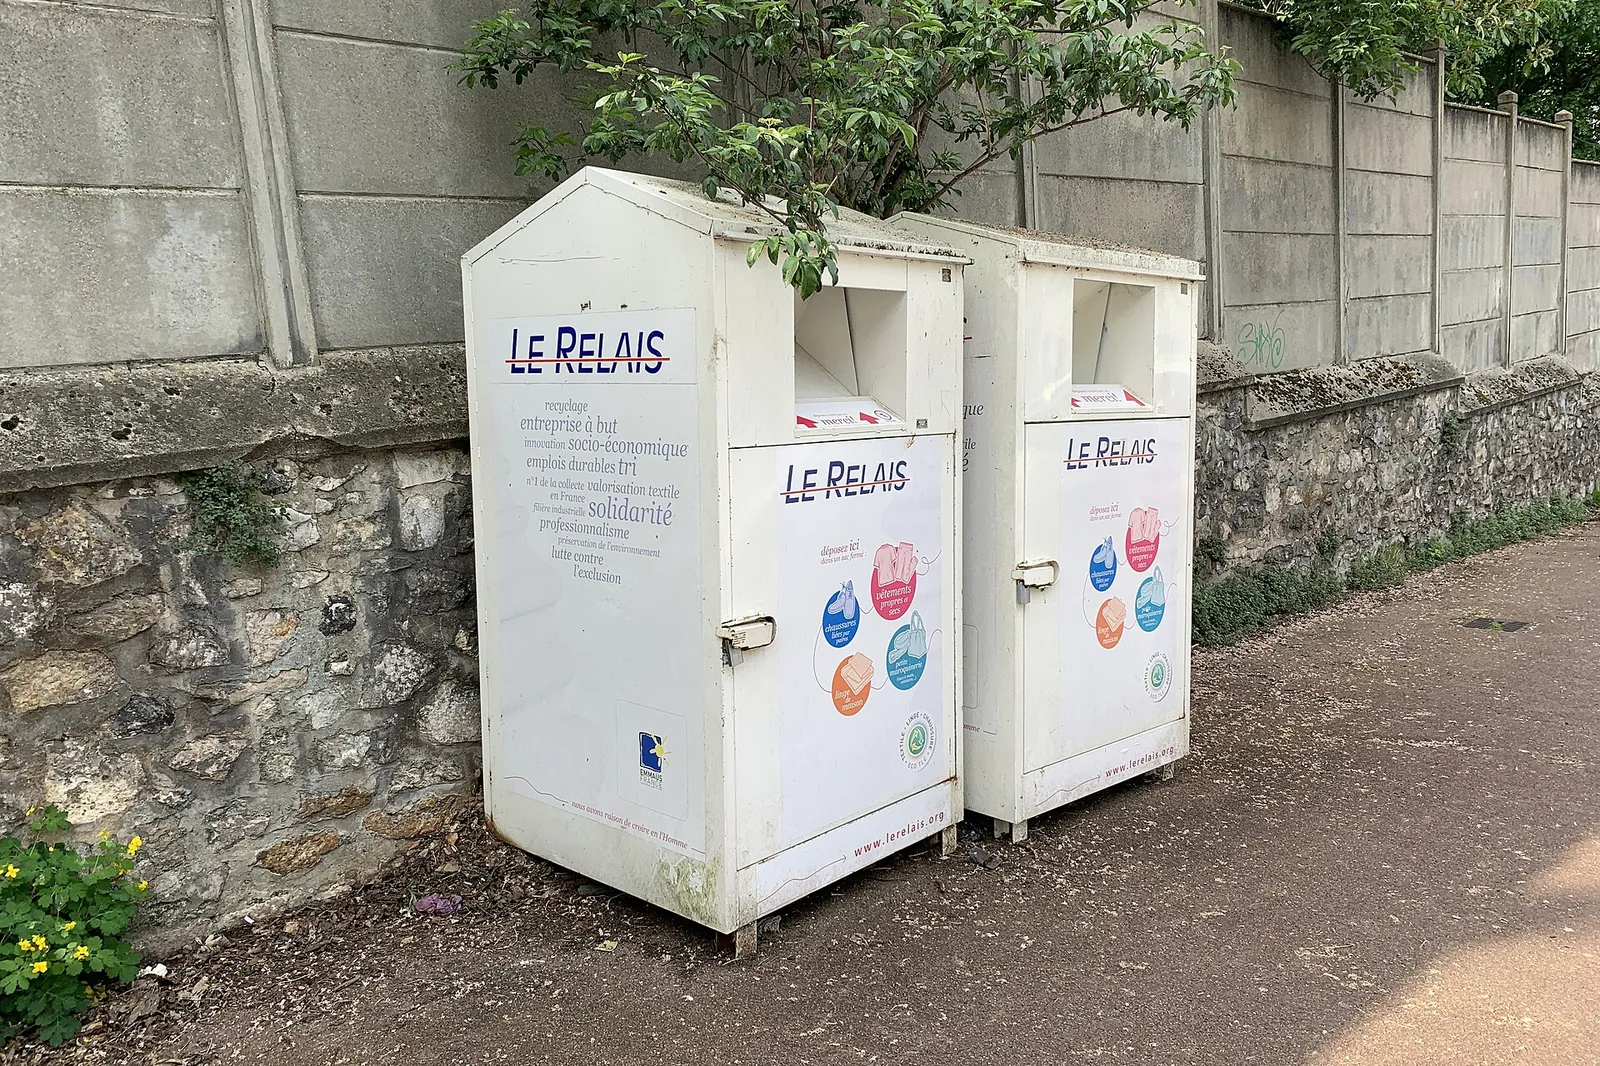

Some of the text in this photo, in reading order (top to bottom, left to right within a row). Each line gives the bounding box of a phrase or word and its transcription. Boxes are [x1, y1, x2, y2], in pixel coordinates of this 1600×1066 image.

[511, 326, 664, 374] LE RELAIS
[545, 399, 588, 414] recyclage
[520, 415, 618, 435] entreprise à but
[524, 434, 689, 461] innovation socio-économique
[1067, 436, 1156, 470] LE RELAIS
[527, 455, 637, 476] emplois durables tri
[540, 477, 549, 487] de
[550, 478, 557, 488] la
[558, 478, 585, 490] collecte
[588, 479, 680, 499] valorisation textile
[785, 460, 907, 504] LE RELAIS
[550, 491, 586, 503] en France
[532, 502, 586, 517] filière industrielle
[588, 496, 672, 526] solidarité
[539, 517, 630, 539] professionnalisme
[552, 545, 604, 565] lutte contre
[557, 536, 660, 557] préservation de l'environnement
[821, 538, 860, 558] déposez ici
[821, 557, 833, 565] dans
[573, 564, 621, 584] l'exclusion
[876, 585, 912, 600] vêtements
[880, 598, 903, 610] propres
[889, 607, 901, 616] secs
[825, 619, 857, 633] chaussures
[1106, 746, 1175, 777] www.lerelais.org
[572, 801, 585, 811] nous
[586, 806, 604, 817] avons
[605, 812, 623, 825] raison
[624, 818, 631, 827] de
[632, 824, 650, 834] croire
[660, 831, 688, 849] l'Homme
[854, 811, 944, 857] www.lerelais.org
